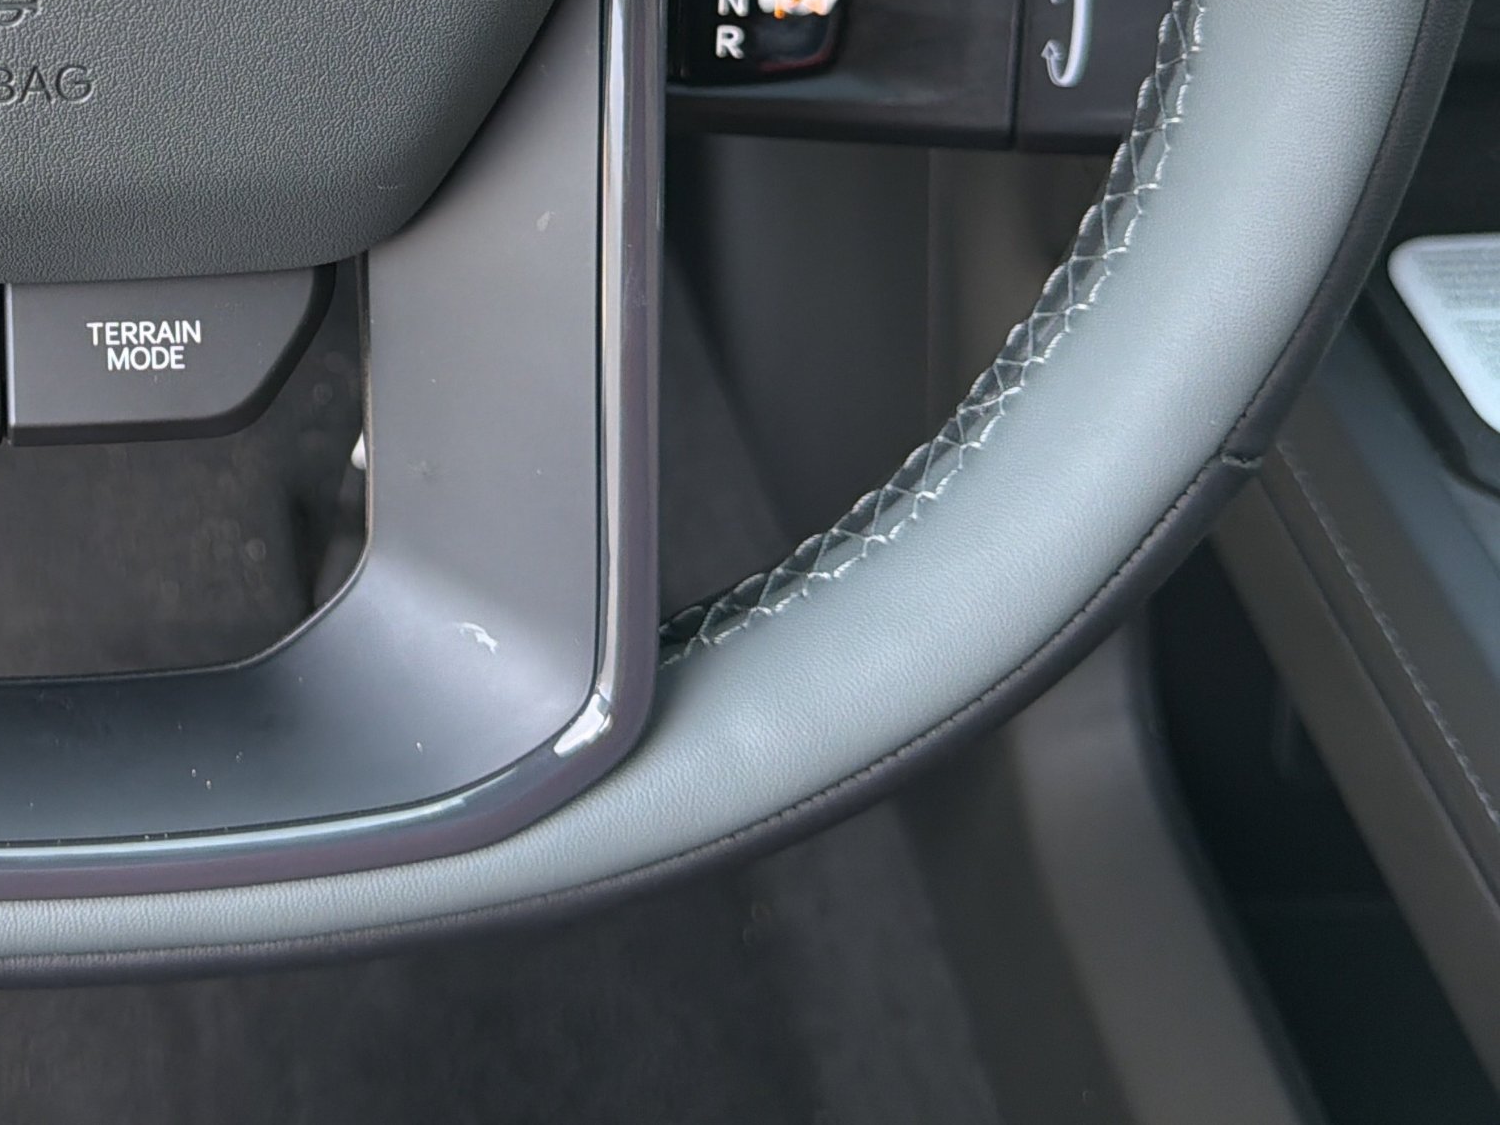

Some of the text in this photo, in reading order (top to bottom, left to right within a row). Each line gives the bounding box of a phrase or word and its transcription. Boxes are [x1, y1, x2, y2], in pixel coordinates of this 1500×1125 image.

[715, 24, 745, 59] R
[86, 320, 202, 346] TERRAIN
[106, 346, 186, 371] MODE
